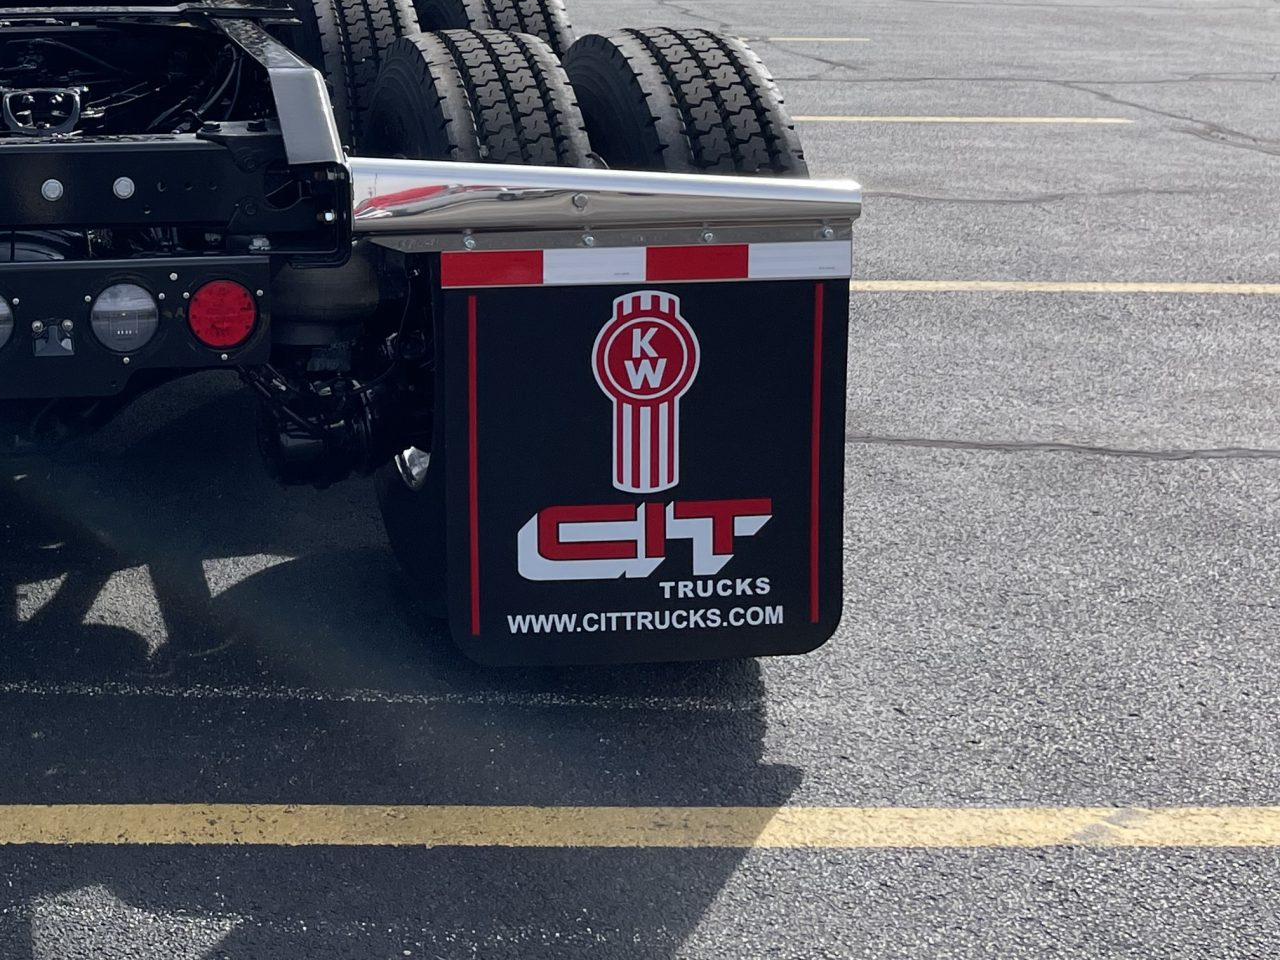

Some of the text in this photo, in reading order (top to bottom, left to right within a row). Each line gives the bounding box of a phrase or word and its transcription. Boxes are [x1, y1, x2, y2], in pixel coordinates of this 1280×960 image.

[632, 328, 659, 358] K
[624, 358, 668, 390] W
[517, 497, 772, 581] CIT
[659, 577, 771, 599] TRUCKS
[507, 605, 784, 634] WWW.CITTRUCKS.COM
